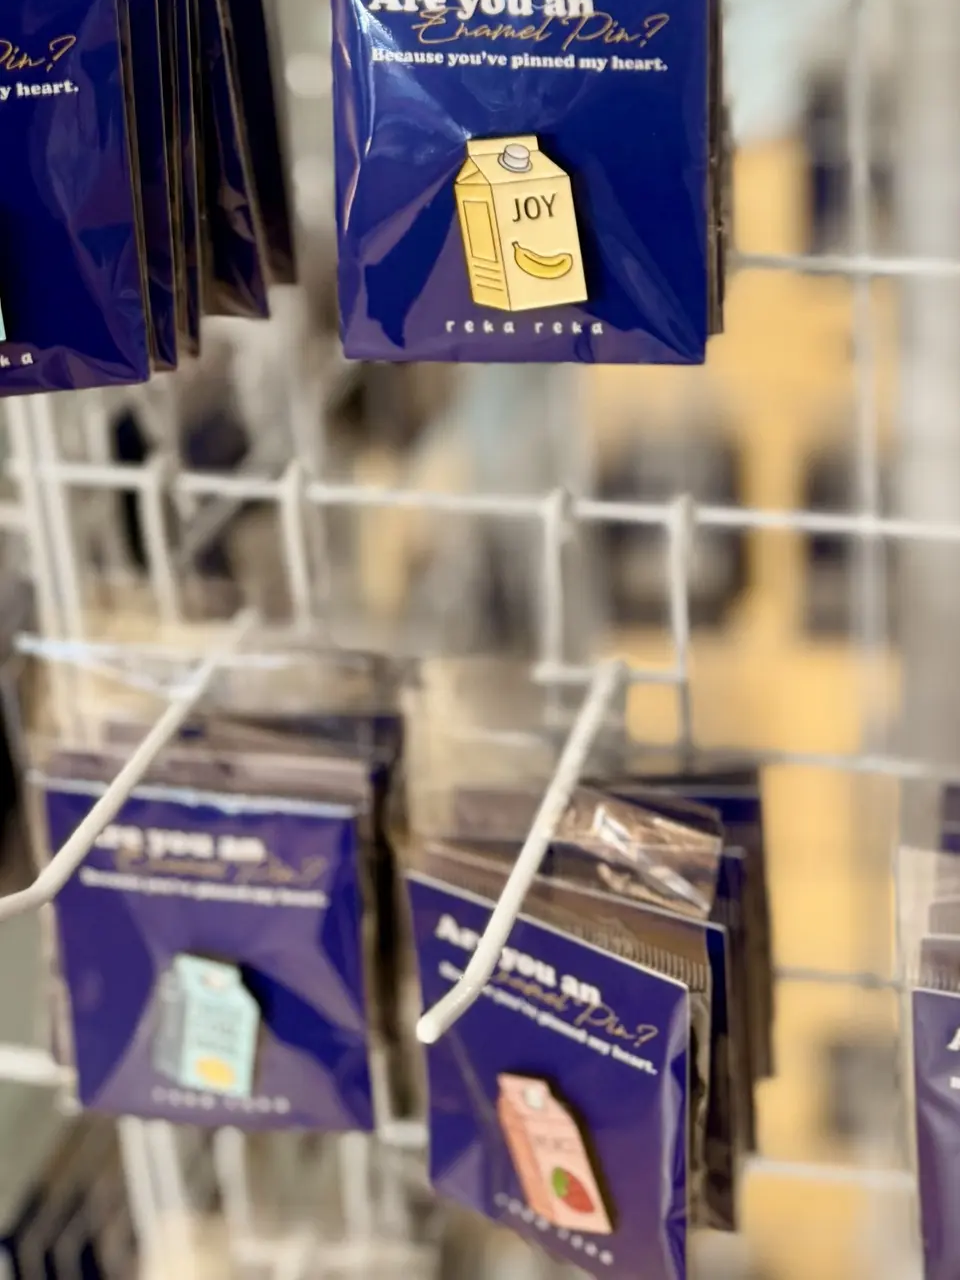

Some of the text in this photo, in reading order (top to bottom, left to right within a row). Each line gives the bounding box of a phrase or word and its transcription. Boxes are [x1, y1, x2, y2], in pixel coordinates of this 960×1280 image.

[411, 7, 670, 51] Enamel Pin?
[0, 35, 76, 73] in?
[372, 48, 668, 72] Because you've pinned my heart.
[16, 80, 79, 98] heart.
[512, 192, 556, 223] JOY
[445, 320, 603, 334] reka reka
[435, 913, 481, 951] Ar
[561, 975, 600, 1007] an
